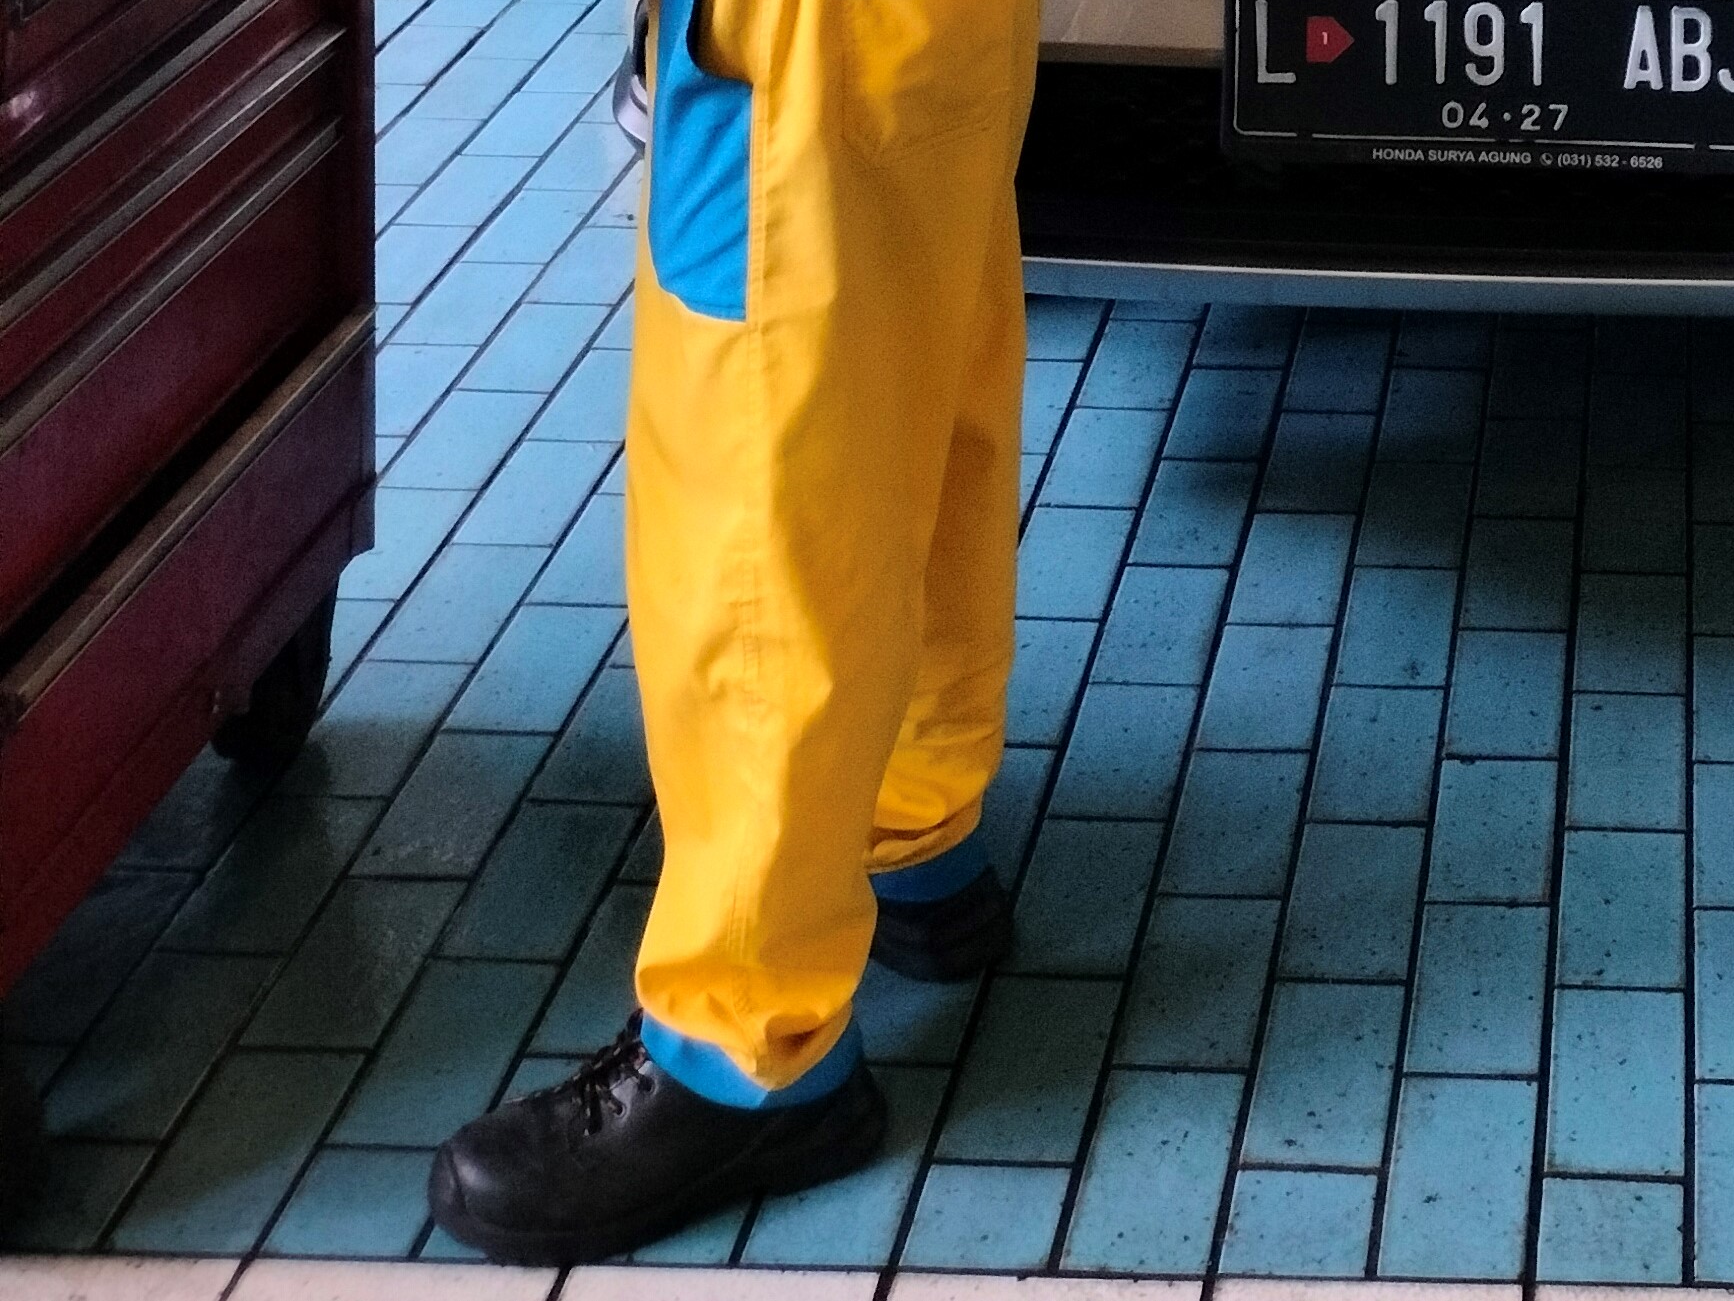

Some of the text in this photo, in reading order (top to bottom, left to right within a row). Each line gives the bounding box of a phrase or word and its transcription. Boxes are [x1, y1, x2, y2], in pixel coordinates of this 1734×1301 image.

[1255, 0, 1297, 84] L
[1375, 0, 1544, 87] 1191
[1372, 148, 1425, 161] HONDA
[1428, 149, 1475, 162] SURYA
[1478, 151, 1532, 164] AGUNG
[1557, 153, 1592, 168] (031)
[1595, 154, 1620, 167] 532
